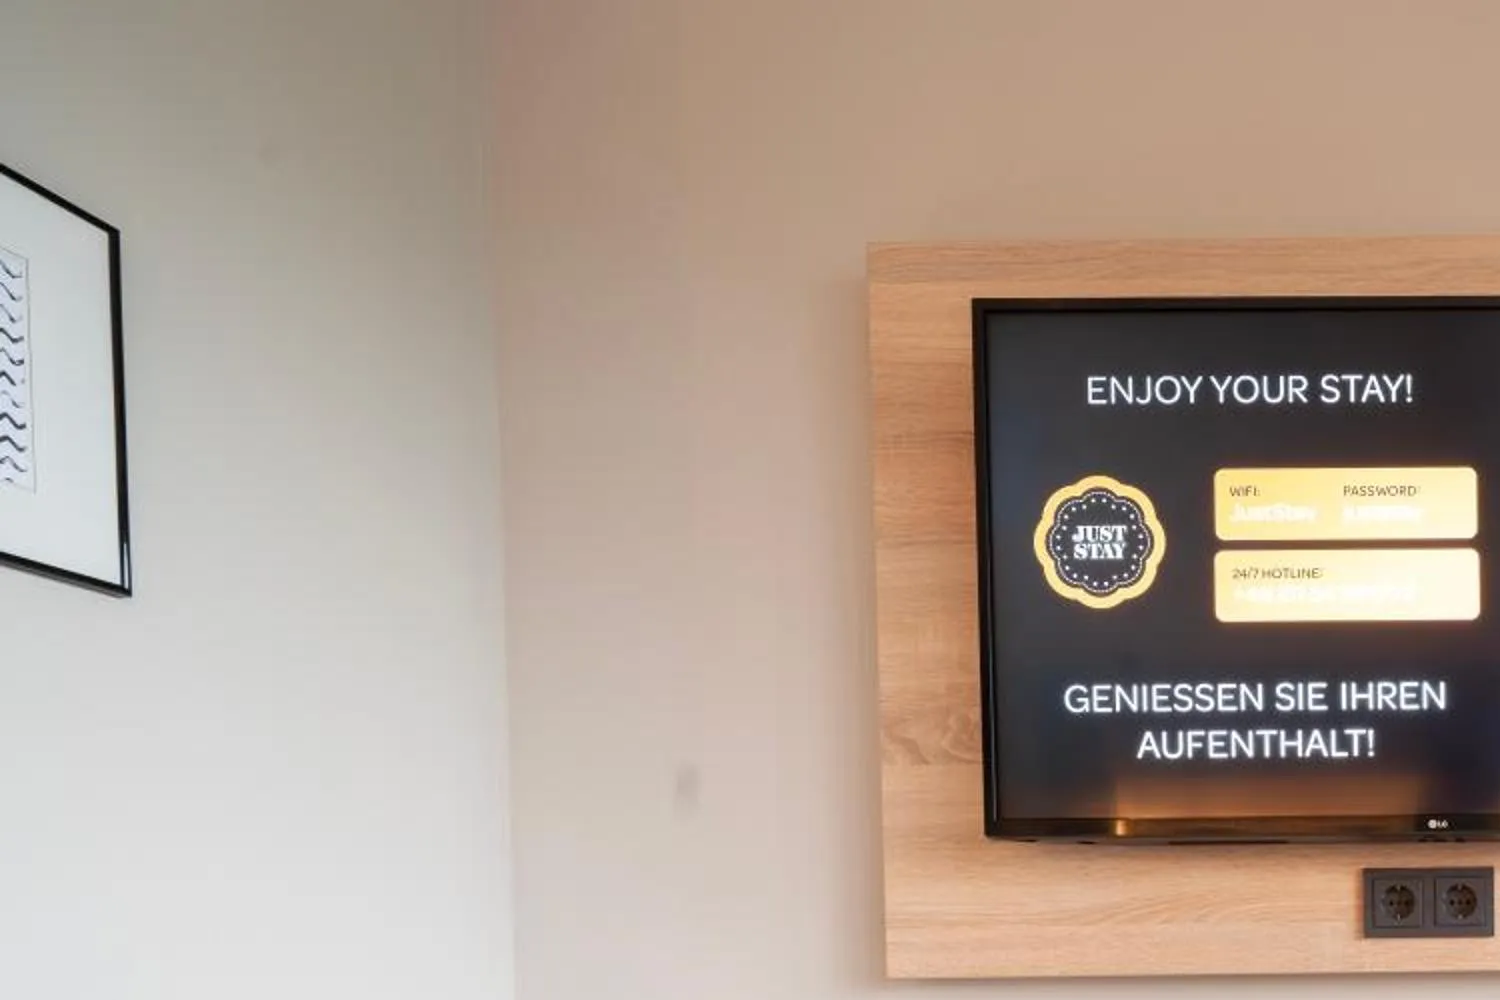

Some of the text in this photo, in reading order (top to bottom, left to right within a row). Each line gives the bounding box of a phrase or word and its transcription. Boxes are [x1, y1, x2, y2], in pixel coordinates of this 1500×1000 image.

[1086, 374, 1414, 405] ENJOY YOUR STAY!
[1229, 485, 1260, 497] WIFI:
[1072, 525, 1127, 543] JUST
[1073, 542, 1127, 560] STAY
[1231, 568, 1259, 580] 24/7
[1063, 681, 1447, 714] GENIESSEN SIE IHREN
[1136, 728, 1376, 760] AUFENTHALT!
